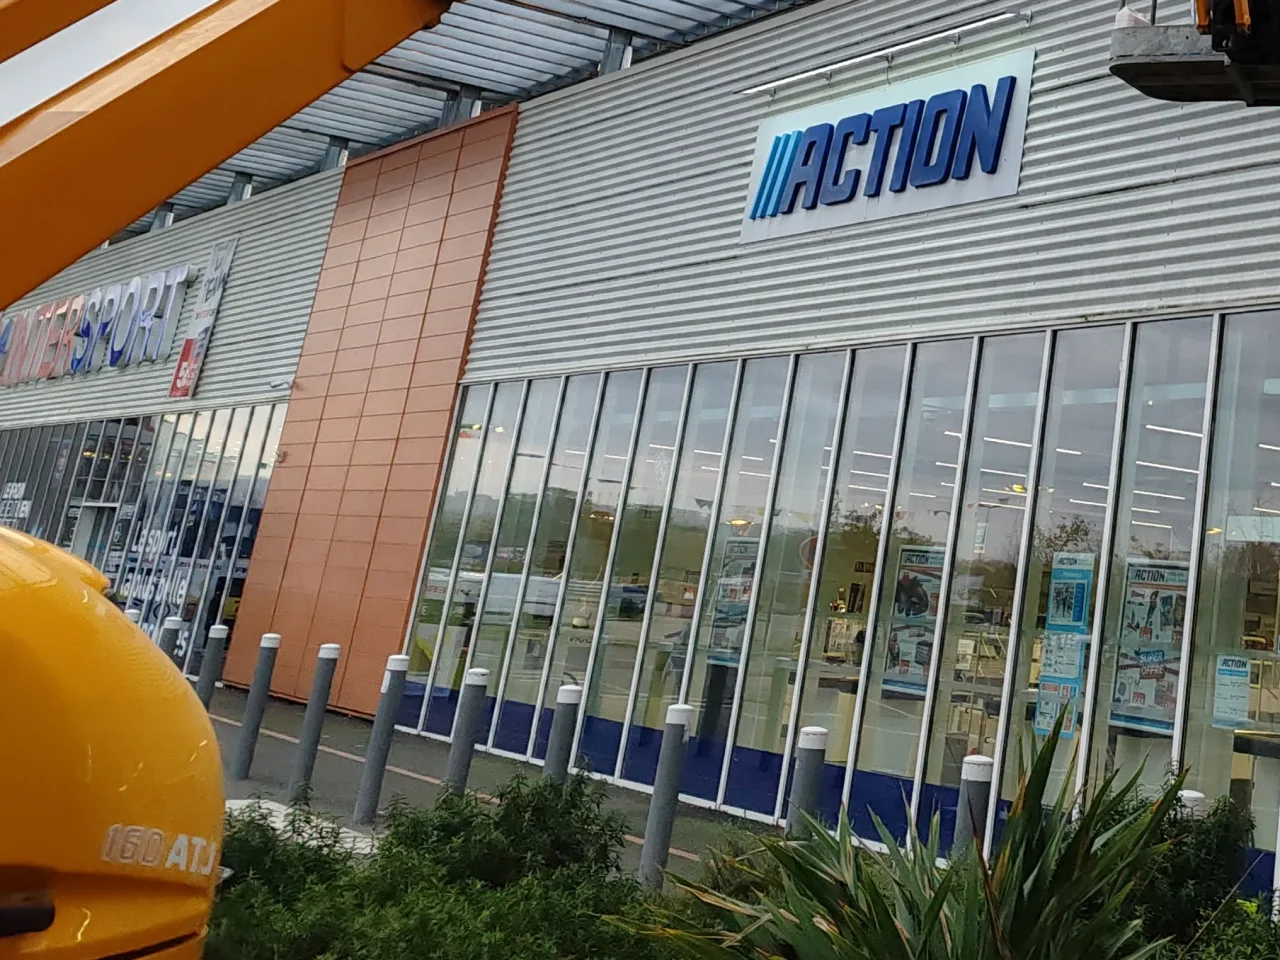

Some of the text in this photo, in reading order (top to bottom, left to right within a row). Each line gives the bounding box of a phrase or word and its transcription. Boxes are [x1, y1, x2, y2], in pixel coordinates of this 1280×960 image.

[778, 75, 1017, 214] ACTION
[1134, 569, 1166, 582] ACTION
[1222, 658, 1248, 669] ACTION
[102, 824, 216, 875] 160 ATJ
